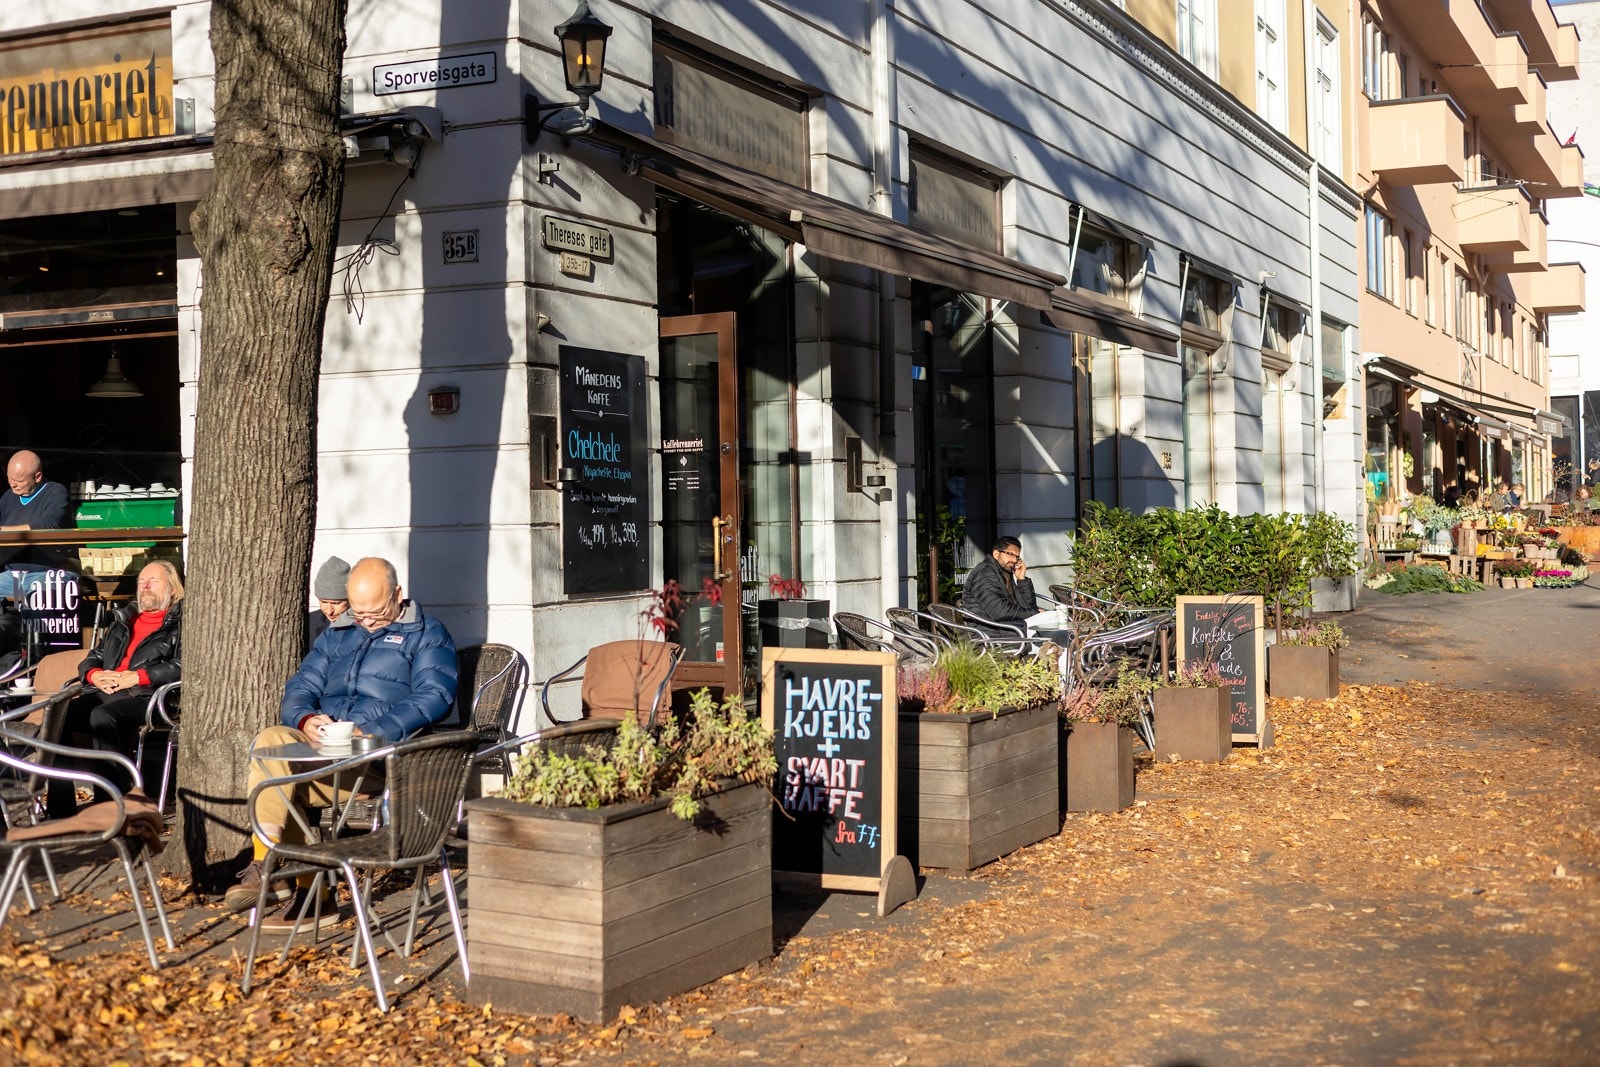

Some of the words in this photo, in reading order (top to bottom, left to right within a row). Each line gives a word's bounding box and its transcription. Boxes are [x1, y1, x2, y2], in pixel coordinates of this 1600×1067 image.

[384, 62, 486, 90] Sporveisgata
[445, 235, 475, 259] 35B
[549, 221, 585, 247] Thereses
[589, 233, 607, 253] gate
[575, 365, 622, 389] MÅNEDENS
[587, 389, 611, 407] KAFFE
[568, 429, 621, 463] Chelchele
[11, 569, 79, 611] Kaffe
[20, 613, 79, 634] renneriet
[1220, 643, 1235, 661] &
[785, 676, 882, 712] HAVRE-
[784, 710, 871, 740] KJEKS
[786, 756, 866, 789] SVART
[783, 785, 863, 820] KAFFE
[834, 820, 856, 844] fra
